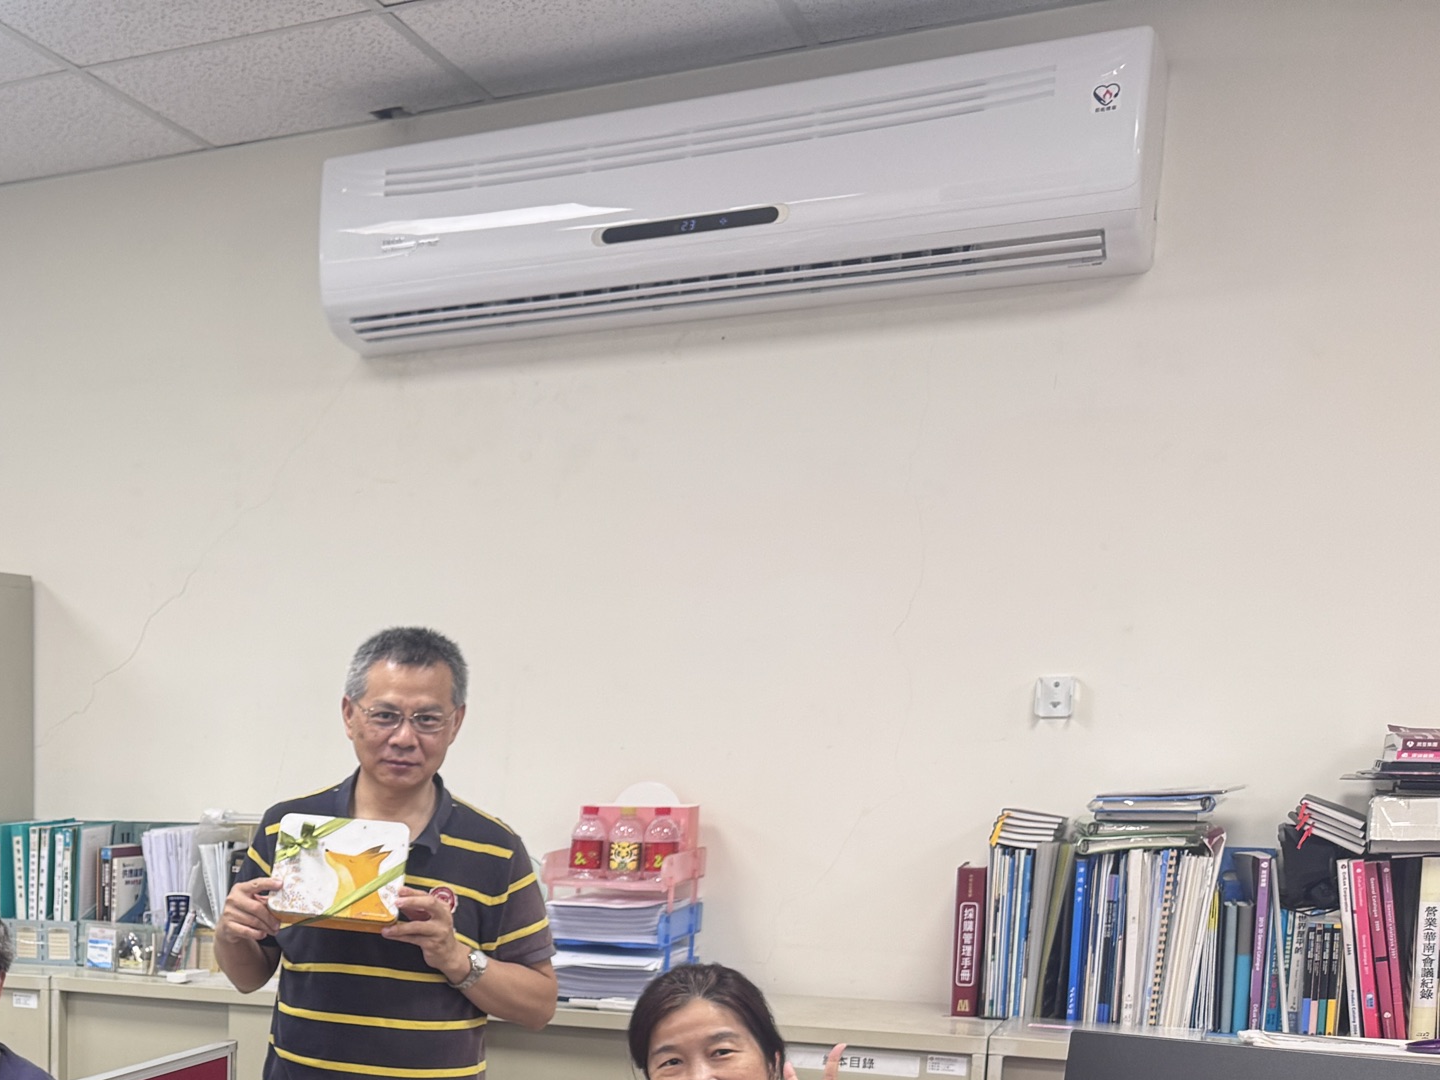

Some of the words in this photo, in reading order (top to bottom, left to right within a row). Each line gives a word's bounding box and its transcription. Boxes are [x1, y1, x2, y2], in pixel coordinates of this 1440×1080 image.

[960, 906, 974, 982] 採購管理手冊
[1419, 905, 1439, 1000] 營業(華南)會議紀錄
[822, 1054, 875, 1070] 本目錄
